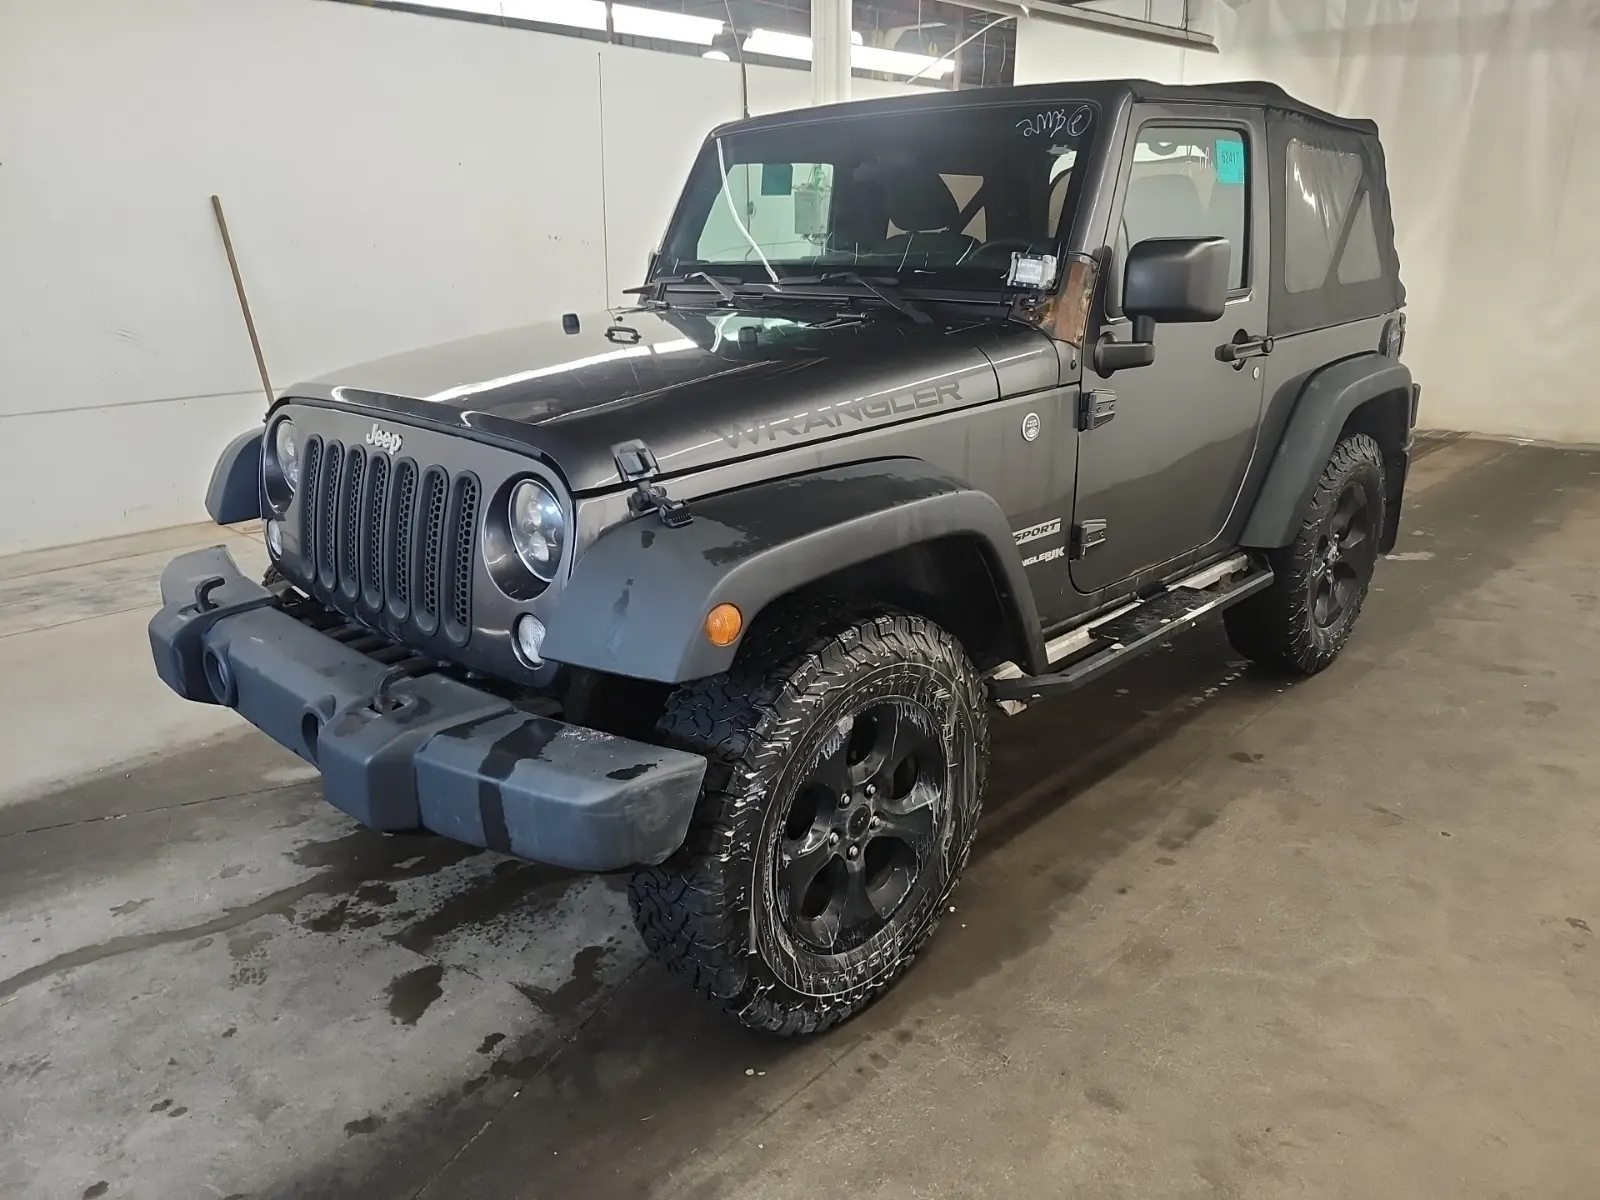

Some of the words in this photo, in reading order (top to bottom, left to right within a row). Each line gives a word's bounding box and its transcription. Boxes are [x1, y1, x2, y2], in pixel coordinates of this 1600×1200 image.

[712, 379, 963, 449] WRANGLER
[366, 423, 402, 456] Jeep
[1013, 522, 1057, 542] SPORT
